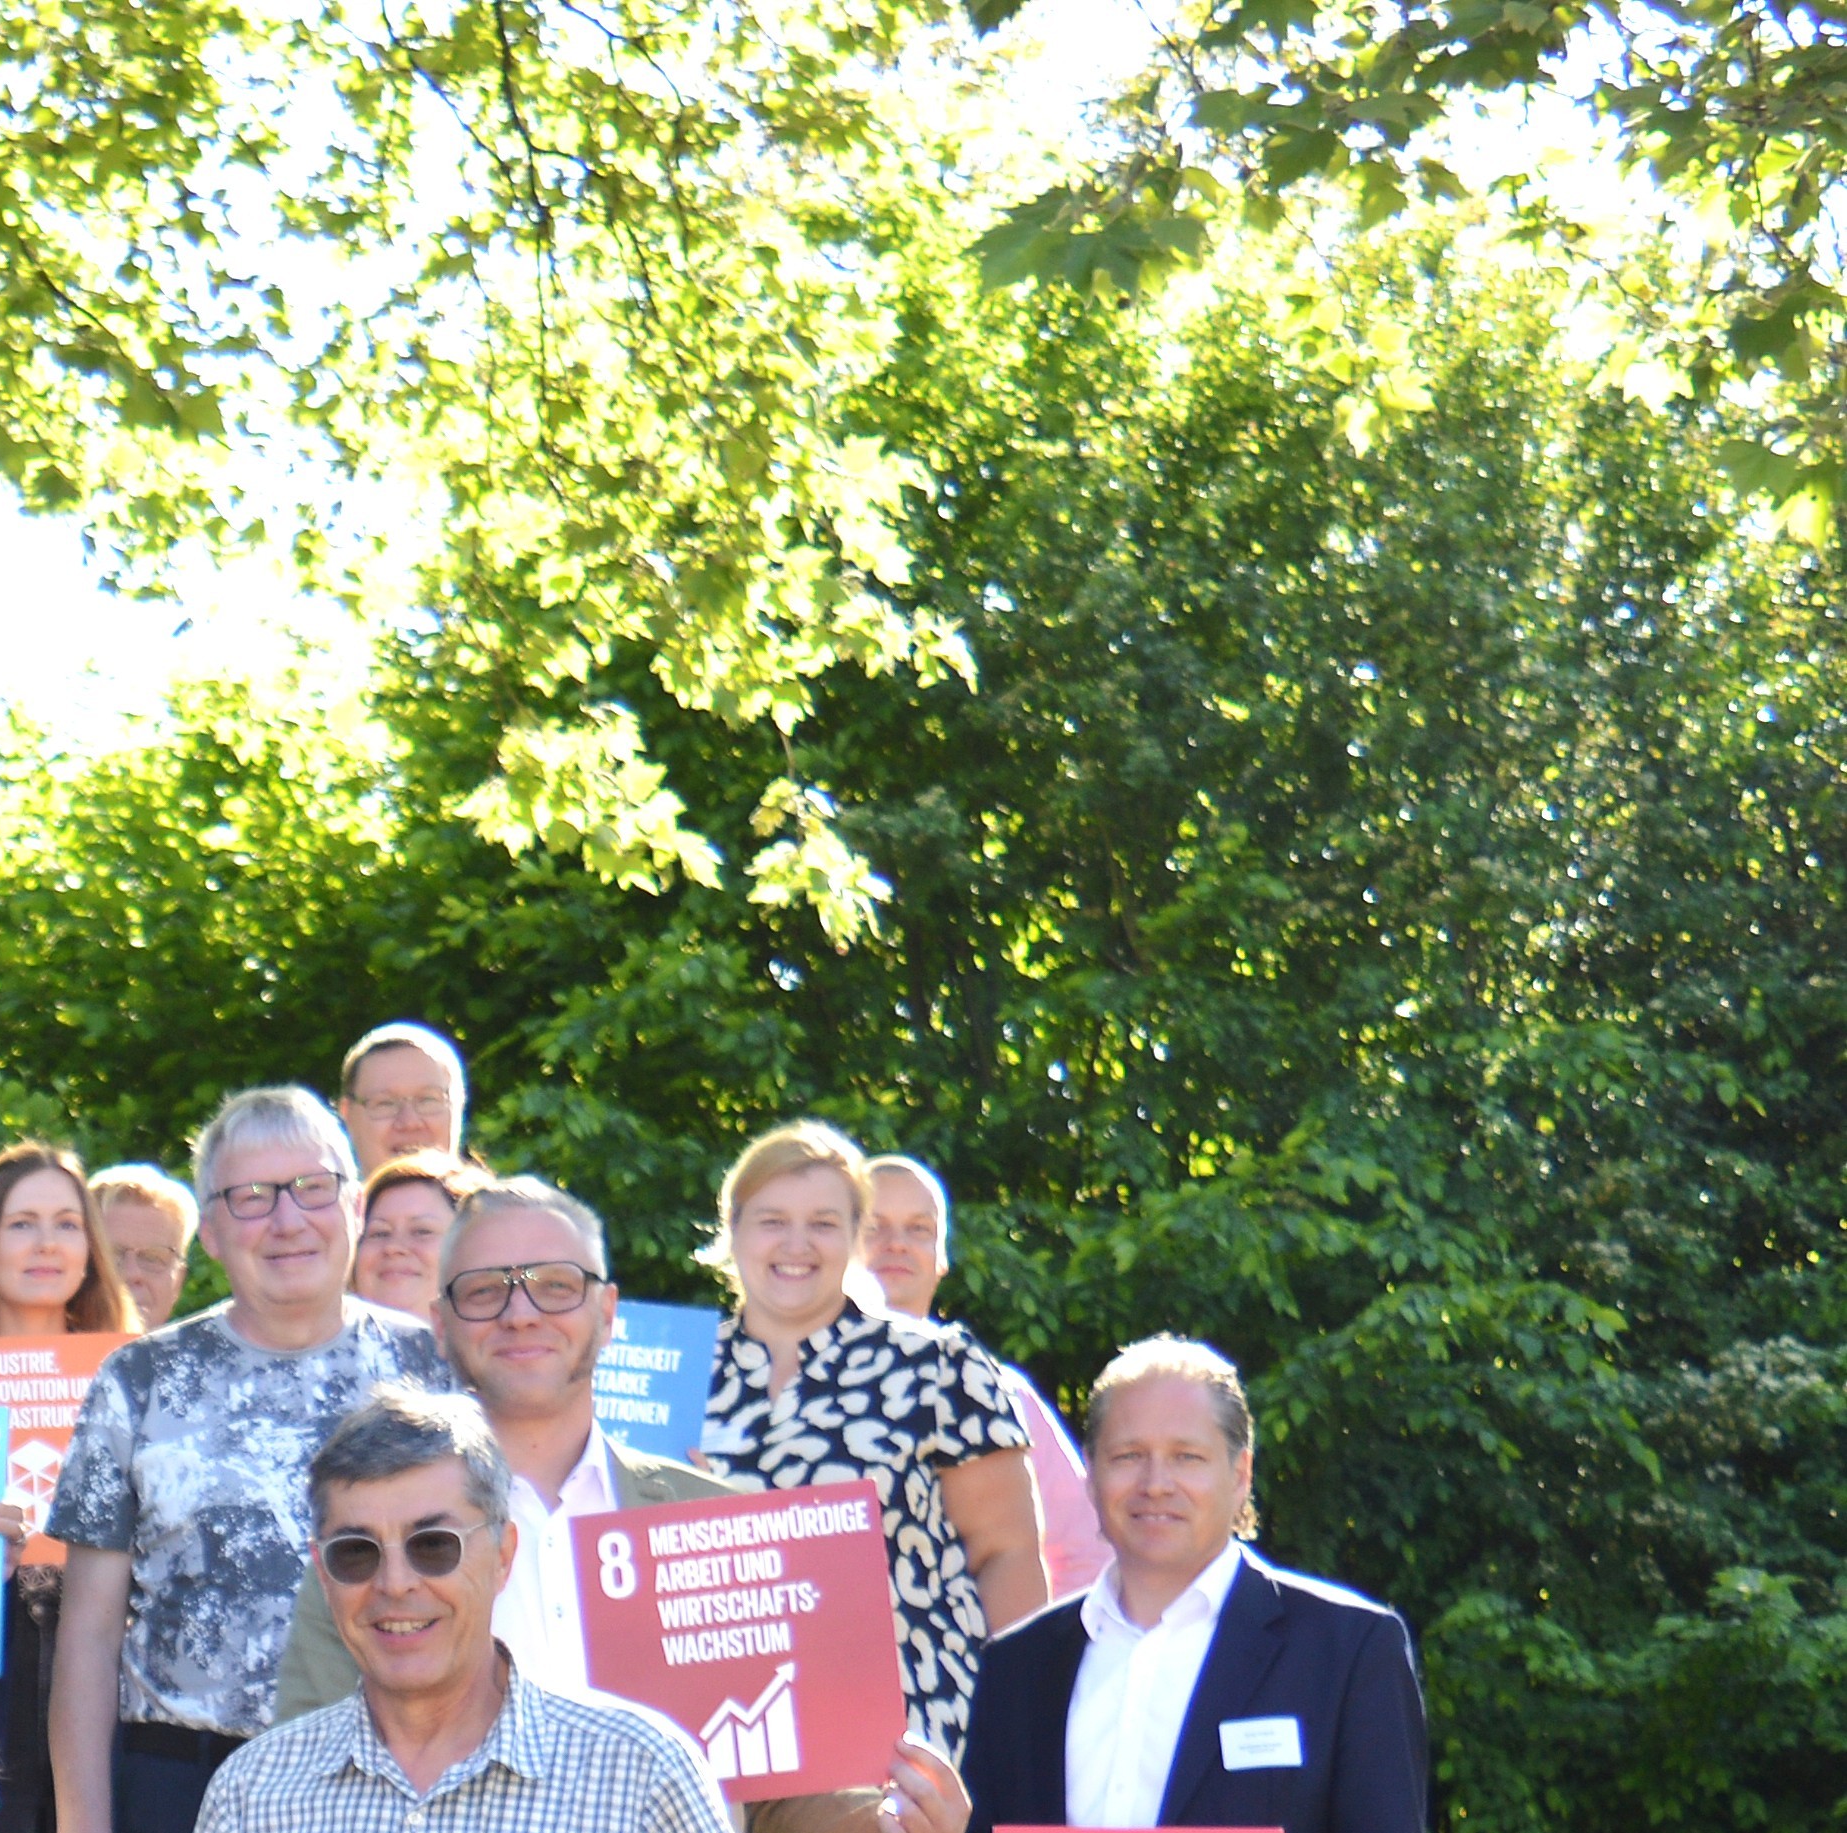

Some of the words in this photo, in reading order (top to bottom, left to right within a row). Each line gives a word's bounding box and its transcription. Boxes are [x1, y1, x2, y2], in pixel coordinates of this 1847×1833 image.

[597, 1532, 636, 1599] 8
[648, 1500, 870, 1558] MENSCHENWÜRDIGE
[655, 1558, 732, 1593] ARBEIT
[734, 1550, 782, 1582] UND
[656, 1583, 820, 1630] WIRTSCHAFTS-
[661, 1622, 791, 1666] WACHSTUM
